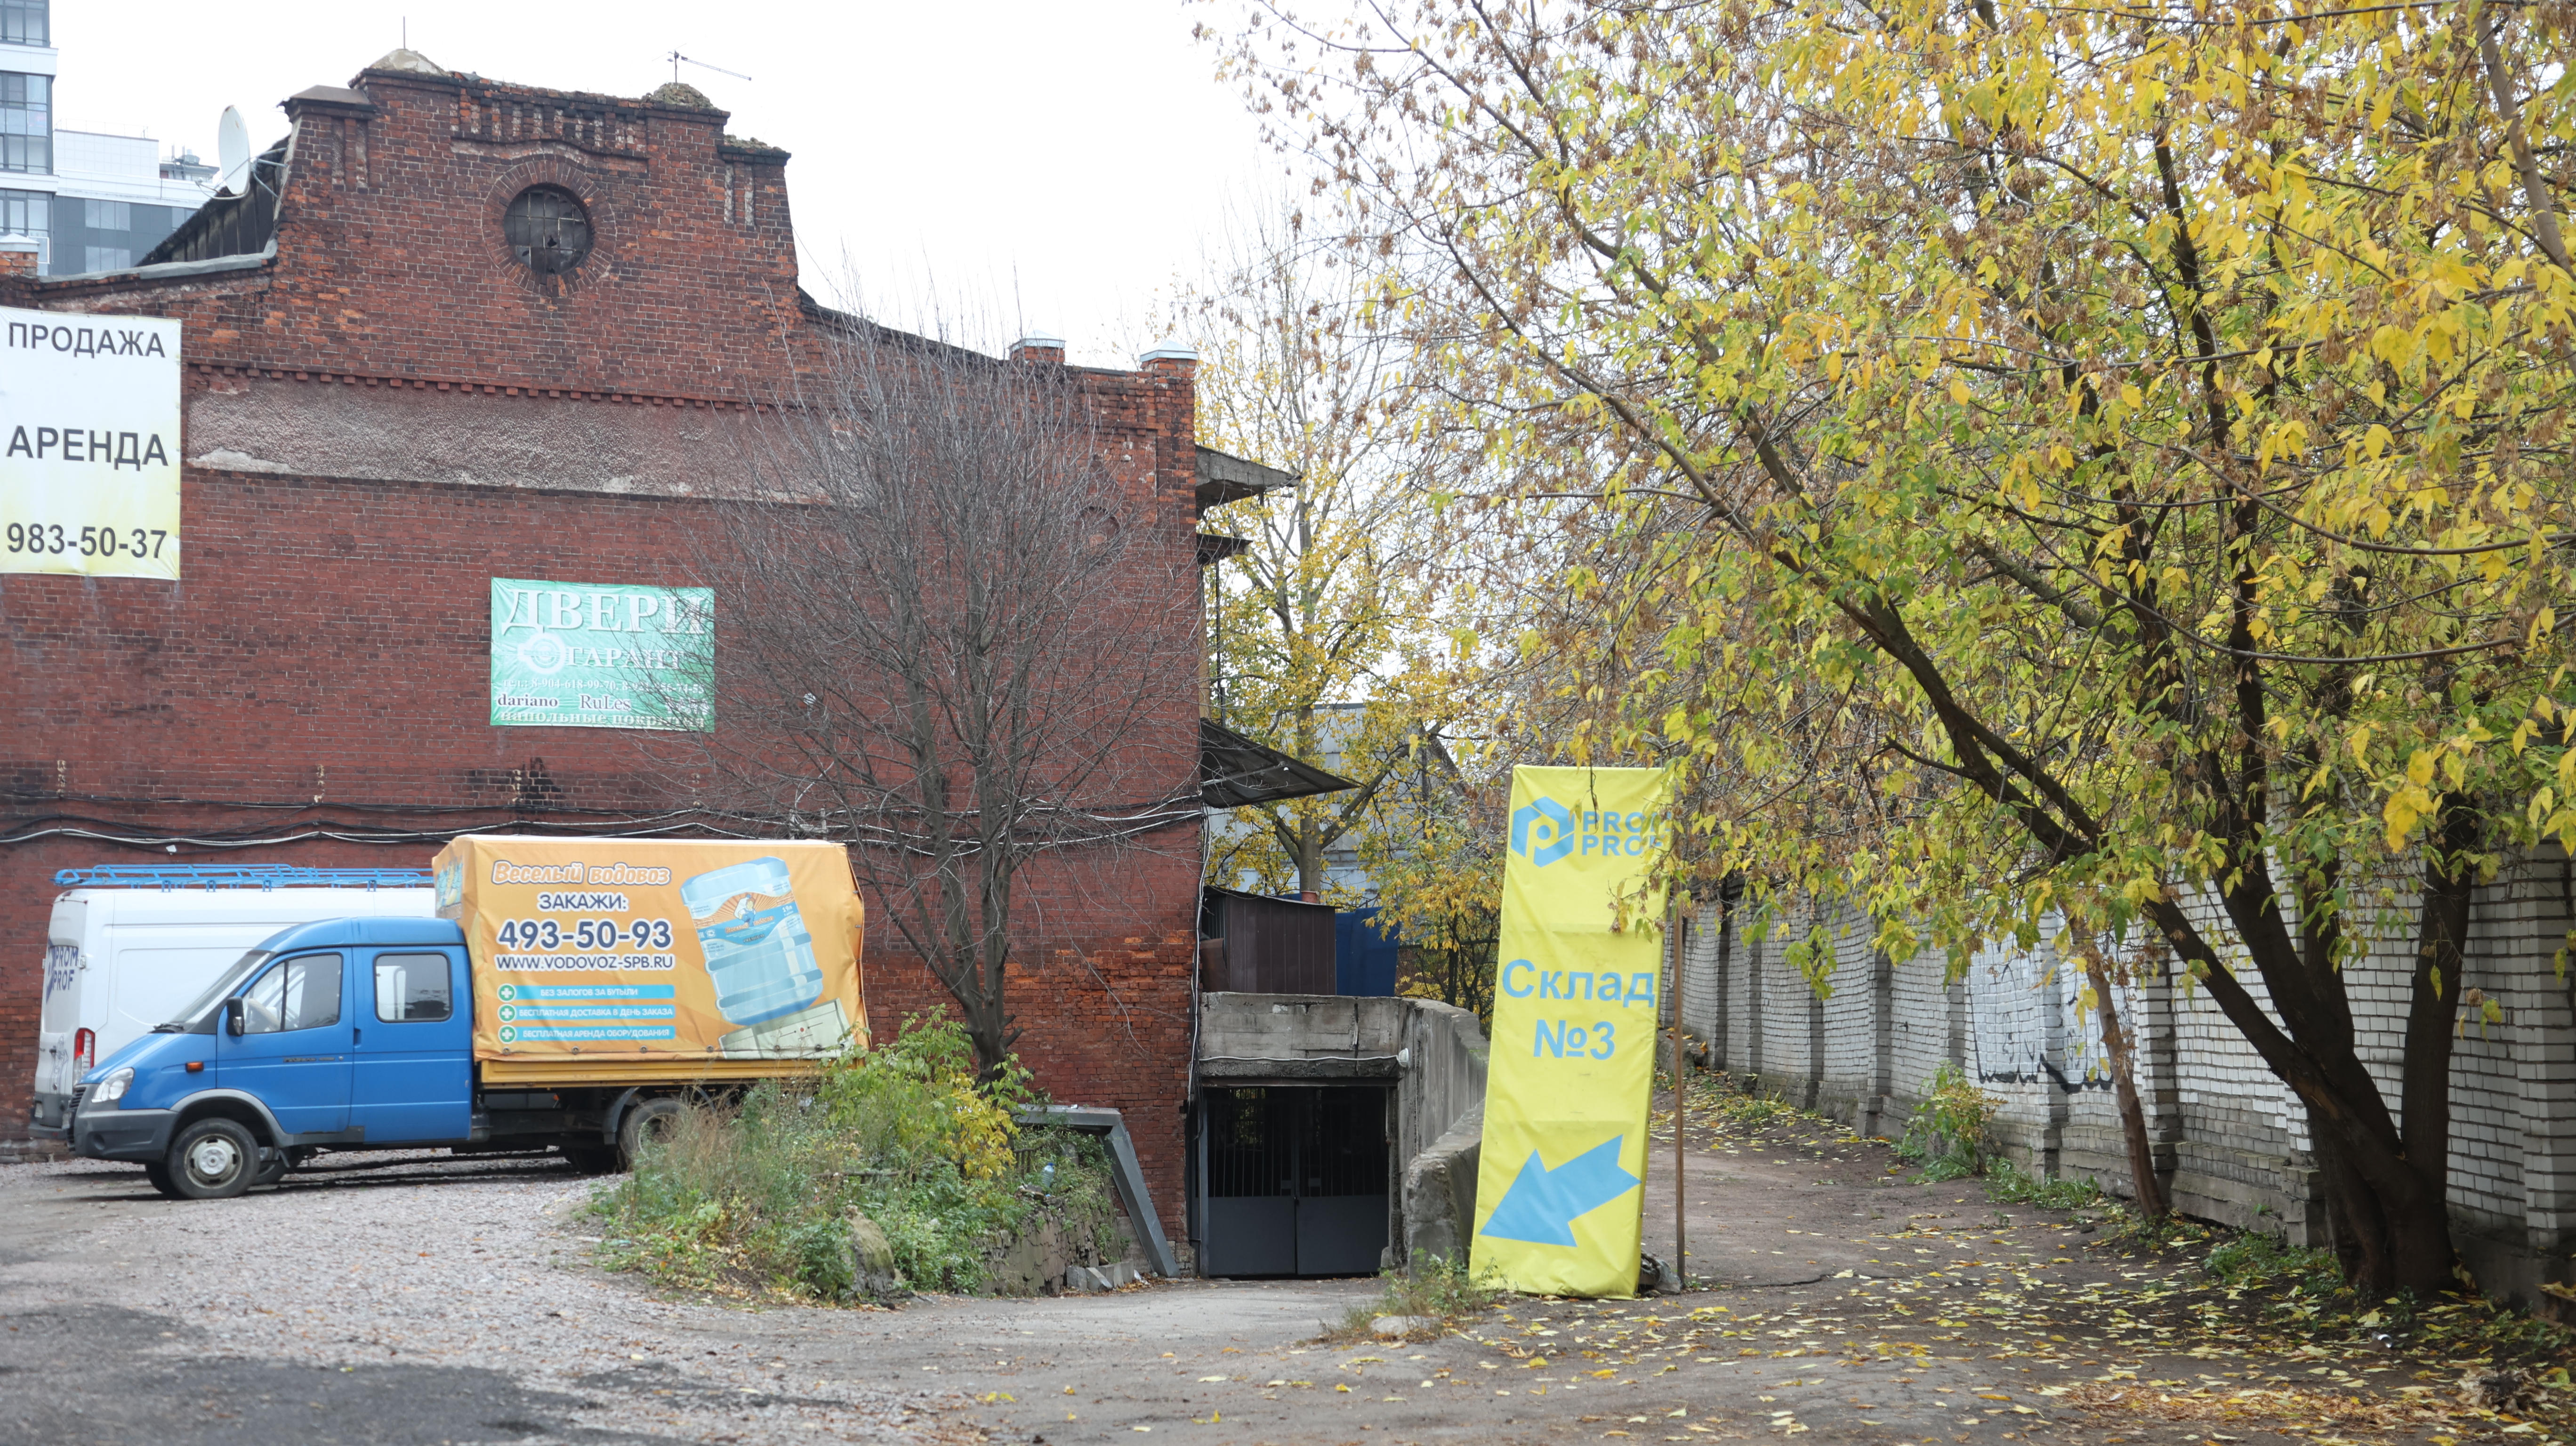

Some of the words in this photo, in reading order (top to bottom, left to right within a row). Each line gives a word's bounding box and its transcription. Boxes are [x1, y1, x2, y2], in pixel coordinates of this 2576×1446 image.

[8, 322, 165, 358] ПРОДАЖА
[6, 426, 169, 471] АРЕНДА
[7, 523, 167, 558] 983-50-37
[501, 589, 708, 635] ДВЕРИ
[567, 646, 686, 669] ГАРАНТ
[498, 694, 558, 707] dariano
[500, 711, 607, 723] напольные
[492, 860, 584, 884] Веселый
[588, 862, 671, 885] водовоз
[539, 894, 627, 909] ЗАКАЖИ:
[499, 921, 671, 948] 493-50-93
[55, 946, 79, 967] PROM
[497, 956, 673, 968] WWW.VODOVOZ-SPB.RU
[52, 970, 74, 990] PROF
[1502, 959, 1656, 1008] Склад
[570, 1009, 611, 1017] ДОСТАВКА
[620, 1009, 641, 1017] ДЕНЬ
[607, 1029, 669, 1037] ОБОРУДОВАНИЯ
[1533, 1019, 1615, 1060] №3
